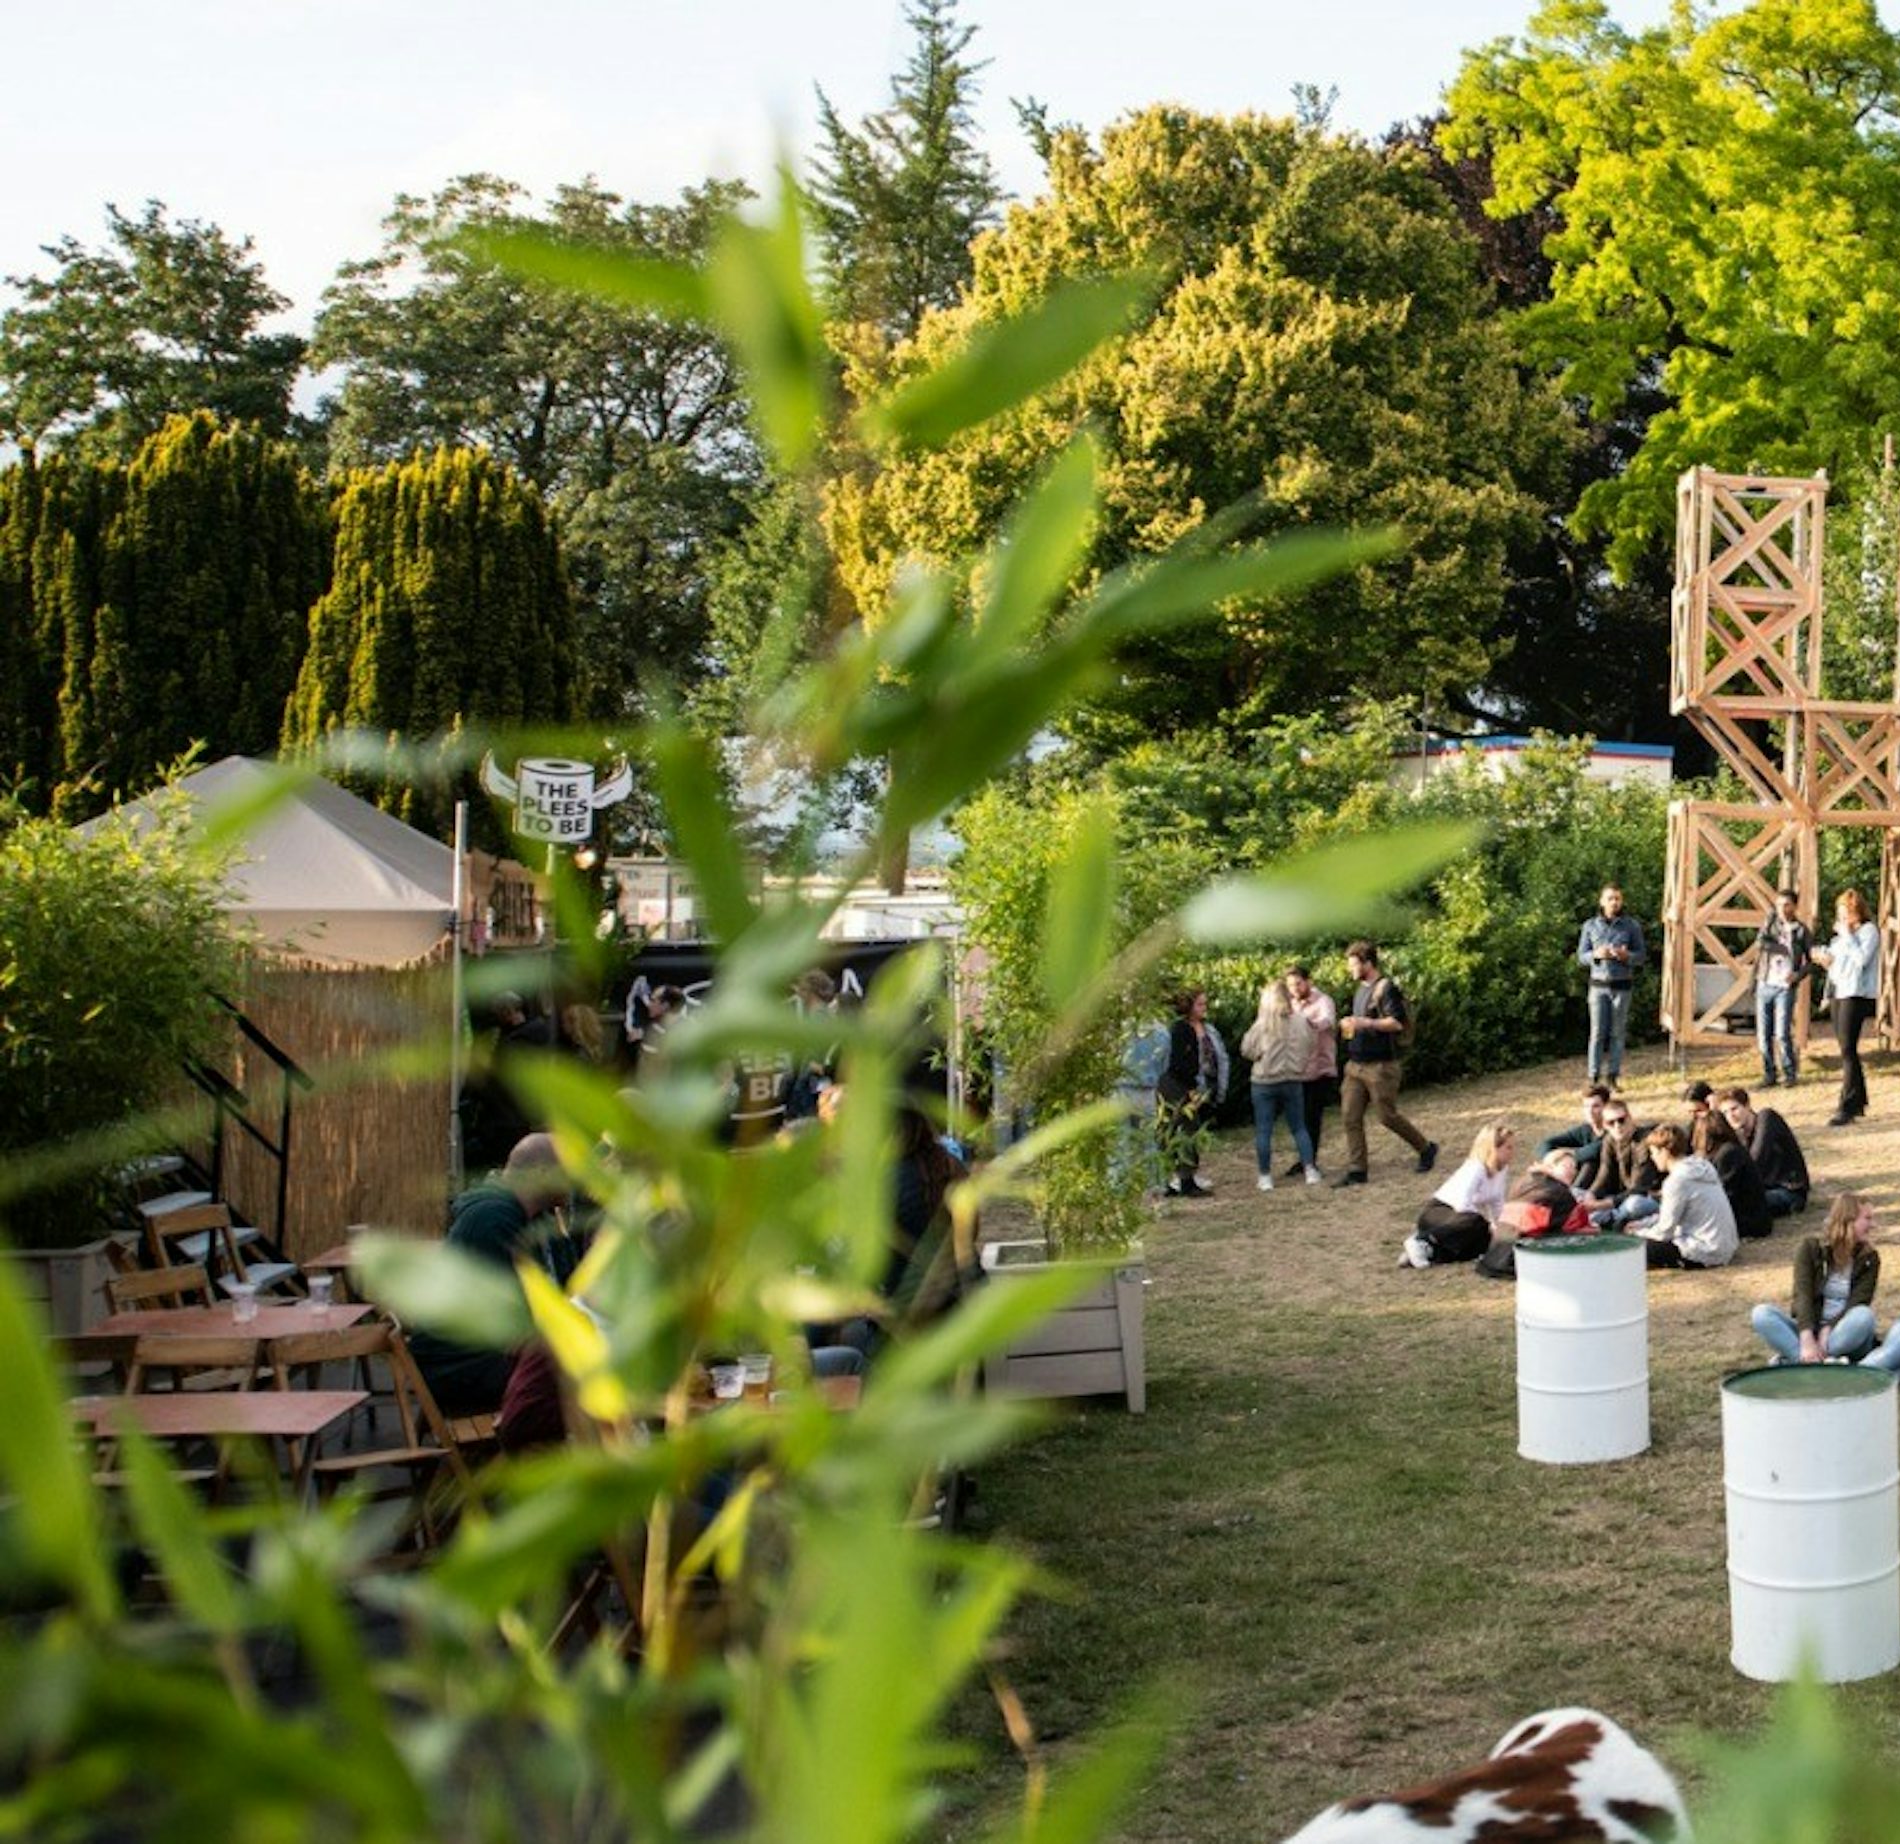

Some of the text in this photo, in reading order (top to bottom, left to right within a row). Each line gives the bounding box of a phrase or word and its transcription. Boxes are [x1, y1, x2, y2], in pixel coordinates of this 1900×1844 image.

[536, 780, 578, 799] THE
[523, 796, 588, 816] PLEES
[523, 814, 586, 834] TO BE
